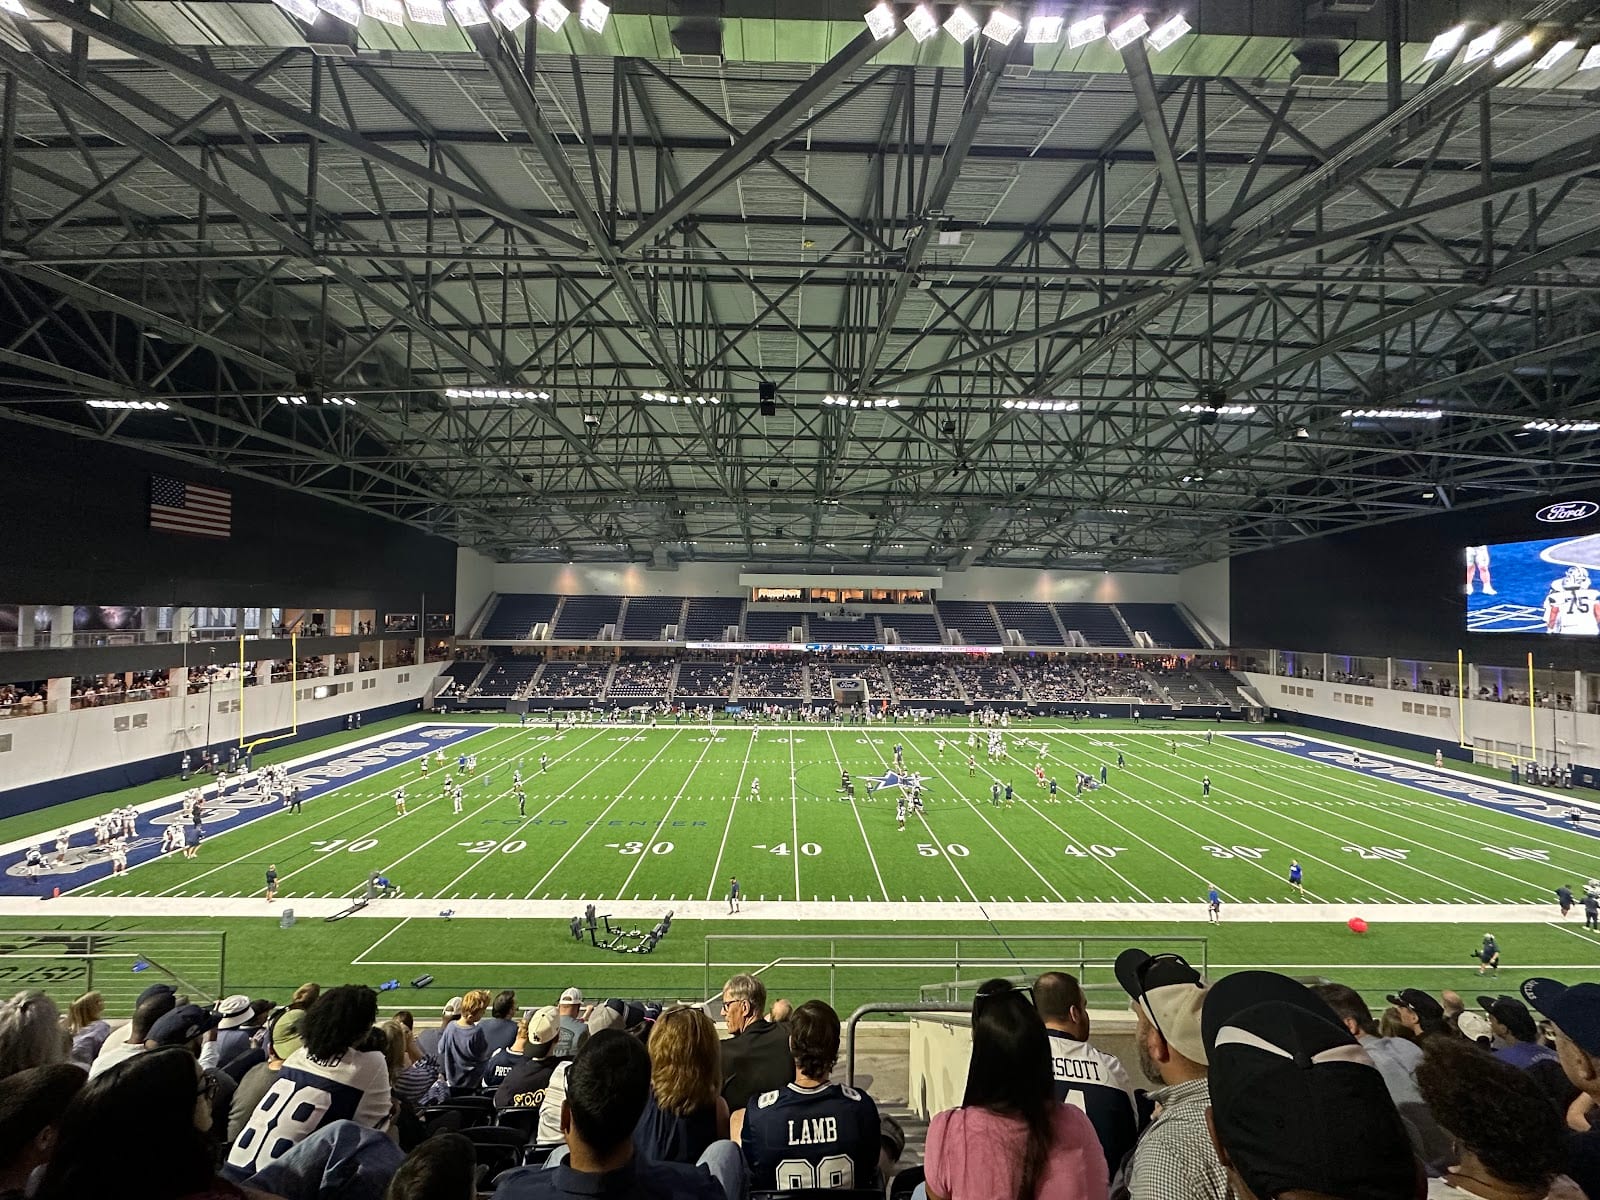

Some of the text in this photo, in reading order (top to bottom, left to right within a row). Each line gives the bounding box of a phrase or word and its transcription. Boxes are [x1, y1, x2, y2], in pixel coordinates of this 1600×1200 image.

[1545, 503, 1588, 521] Ford
[1565, 596, 1590, 614] 75
[313, 838, 379, 853] 10
[465, 839, 528, 854] 20
[618, 841, 675, 856] 30
[769, 842, 823, 856] 40
[916, 843, 971, 857] 50
[1064, 844, 1117, 858] 40
[1201, 845, 1263, 859] 30
[1341, 846, 1408, 860] 20
[1052, 1057, 1101, 1081] SCOTT
[227, 1077, 332, 1173] 88
[787, 1116, 838, 1146] LAMB
